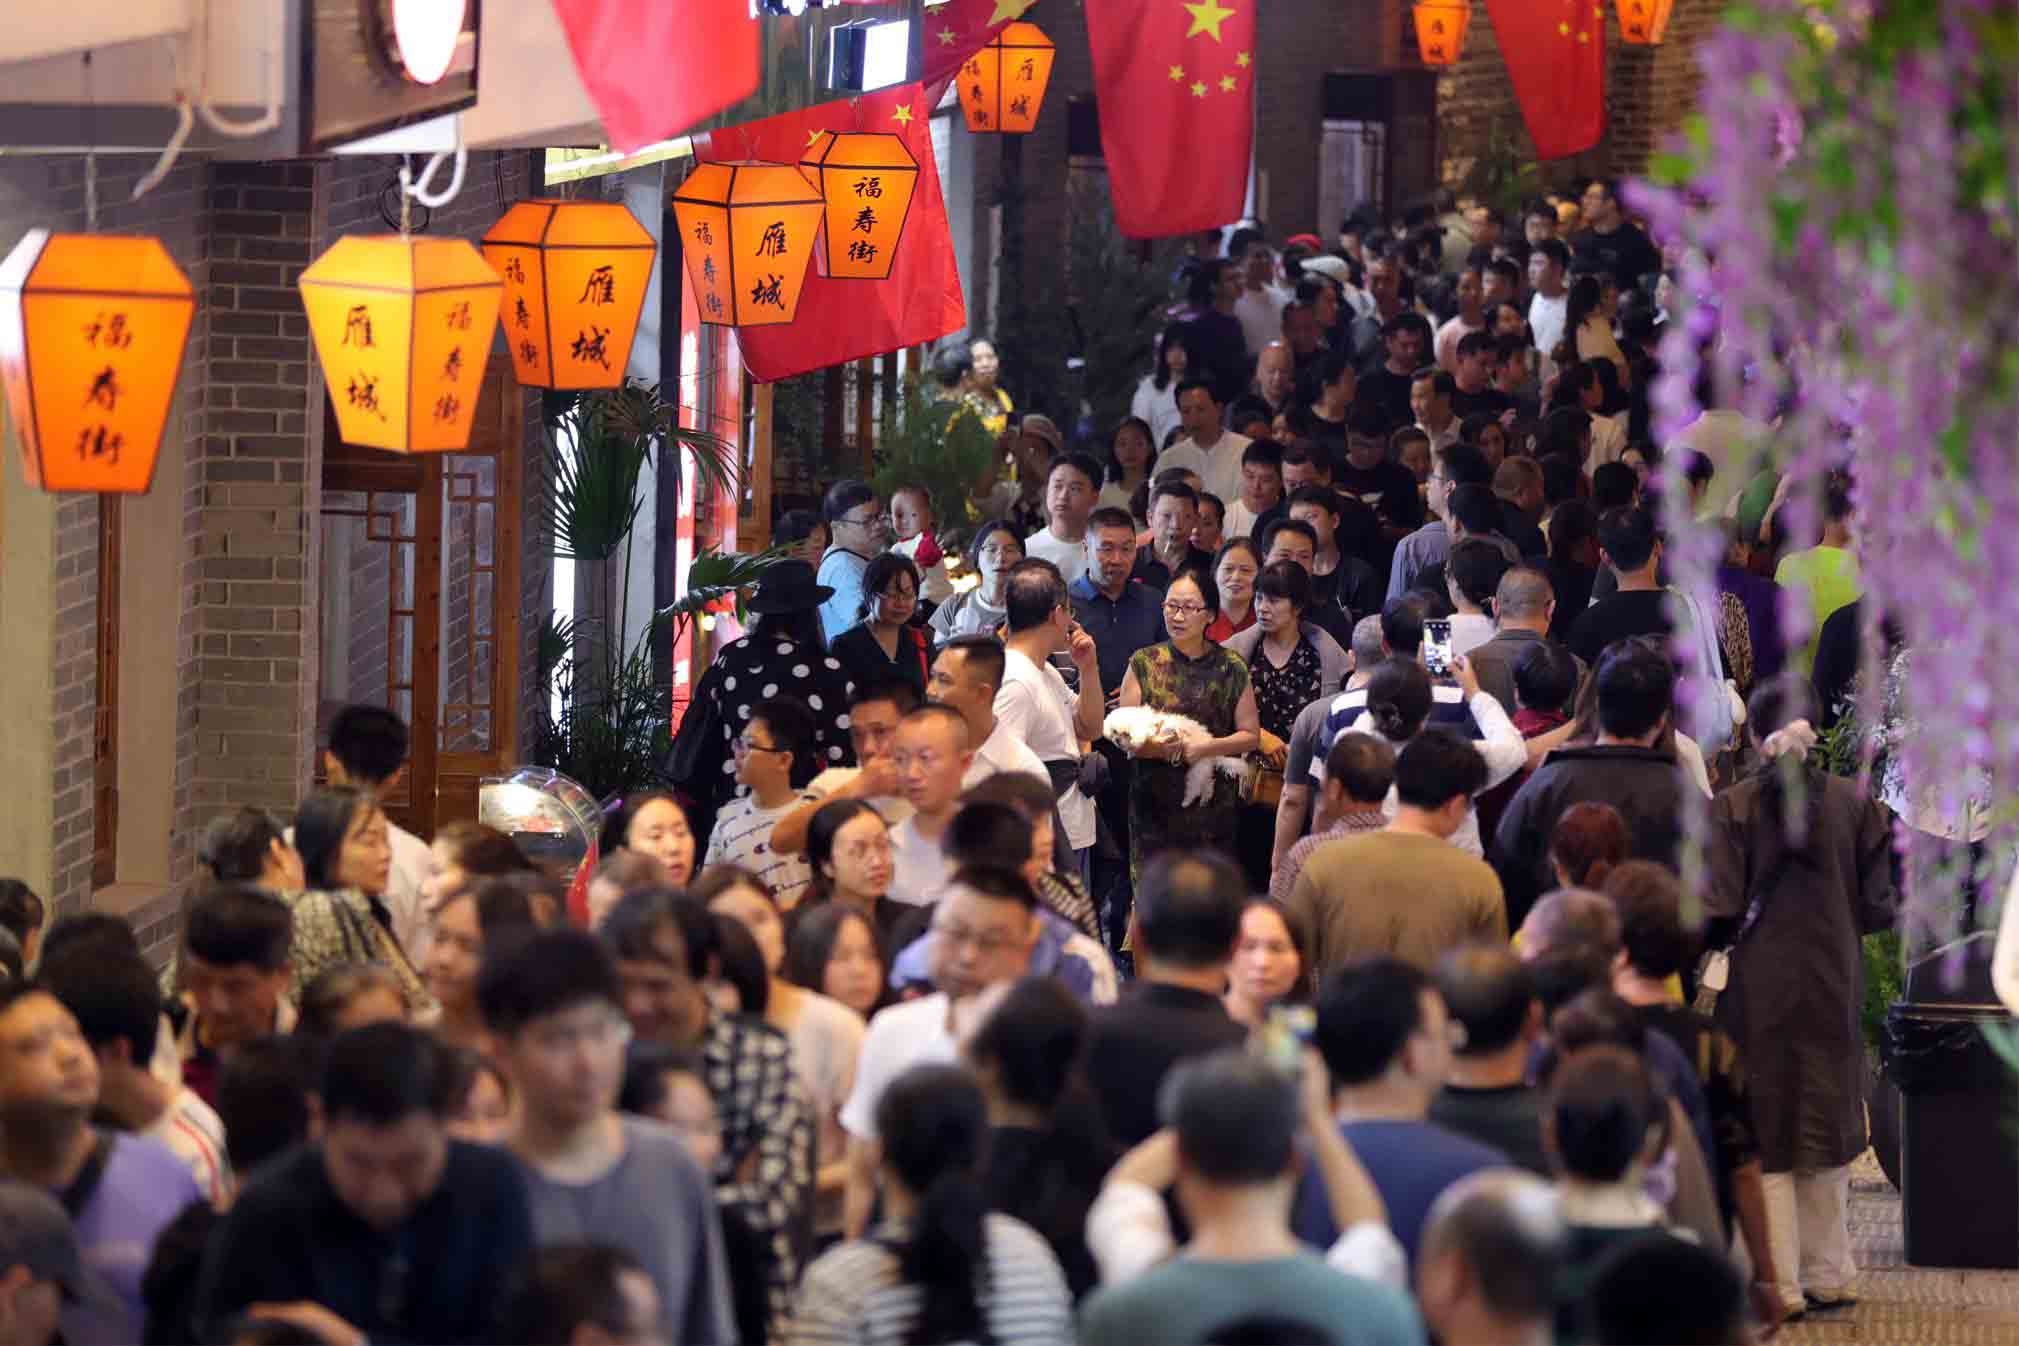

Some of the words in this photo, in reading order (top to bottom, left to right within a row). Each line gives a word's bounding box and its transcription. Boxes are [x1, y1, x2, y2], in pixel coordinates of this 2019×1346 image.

[751, 220, 788, 311] 雁城
[848, 176, 884, 265] 福寿街
[571, 264, 615, 371] 雁城
[694, 221, 723, 319] 福寿街
[341, 304, 388, 423] 雁城
